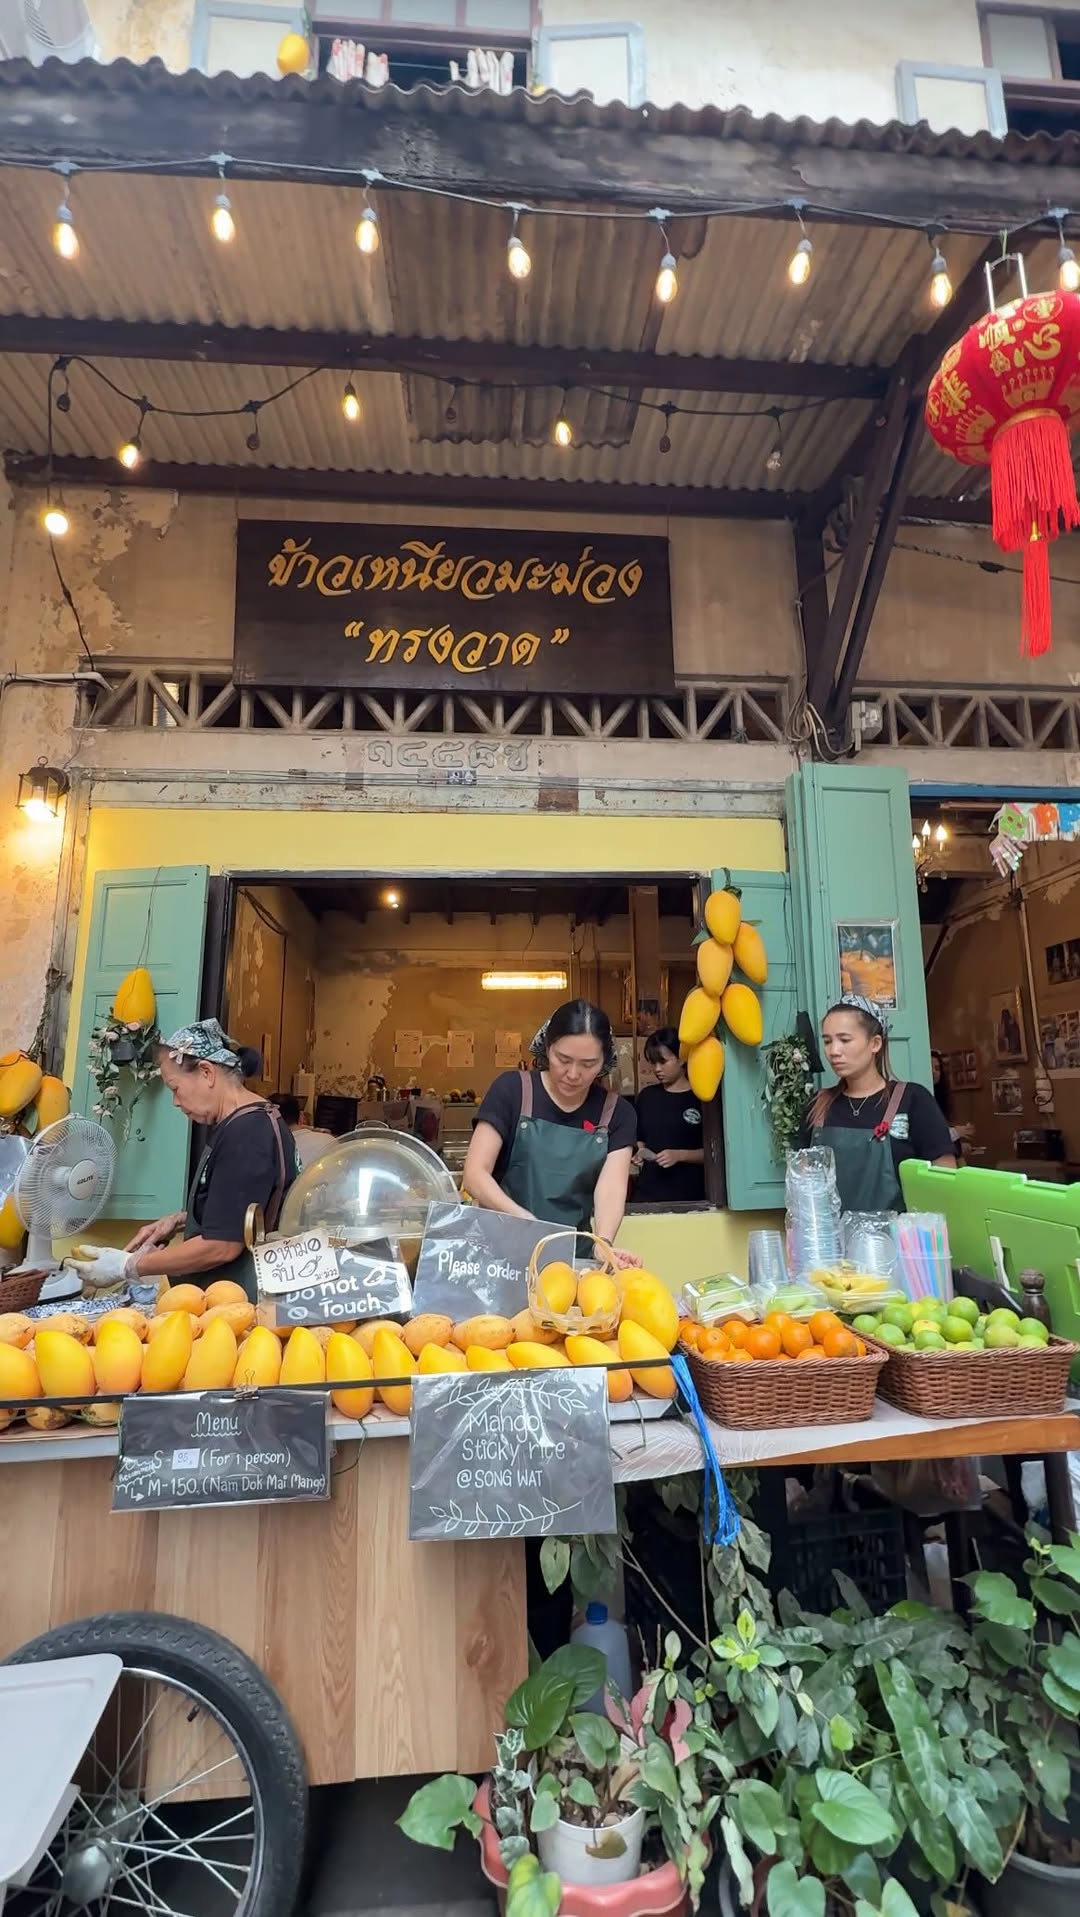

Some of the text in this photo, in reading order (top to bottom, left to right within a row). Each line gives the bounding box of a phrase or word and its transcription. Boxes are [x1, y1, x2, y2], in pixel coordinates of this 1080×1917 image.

[267, 537, 643, 604] ข้าวเหนียวมะม่วง
[277, 1239, 308, 1260] ห้าม
[271, 1262, 296, 1283] จับ
[438, 1250, 480, 1275] Please
[486, 1262, 522, 1281] order
[320, 1275, 360, 1296] not
[318, 1292, 381, 1318] Touch
[196, 1412, 239, 1432] Menu
[468, 1411, 541, 1443] Mango
[462, 1439, 567, 1466] Sticky rice
[241, 1472, 263, 1492] Dok
[266, 1473, 287, 1490] Mai
[516, 1469, 544, 1488] WAT
